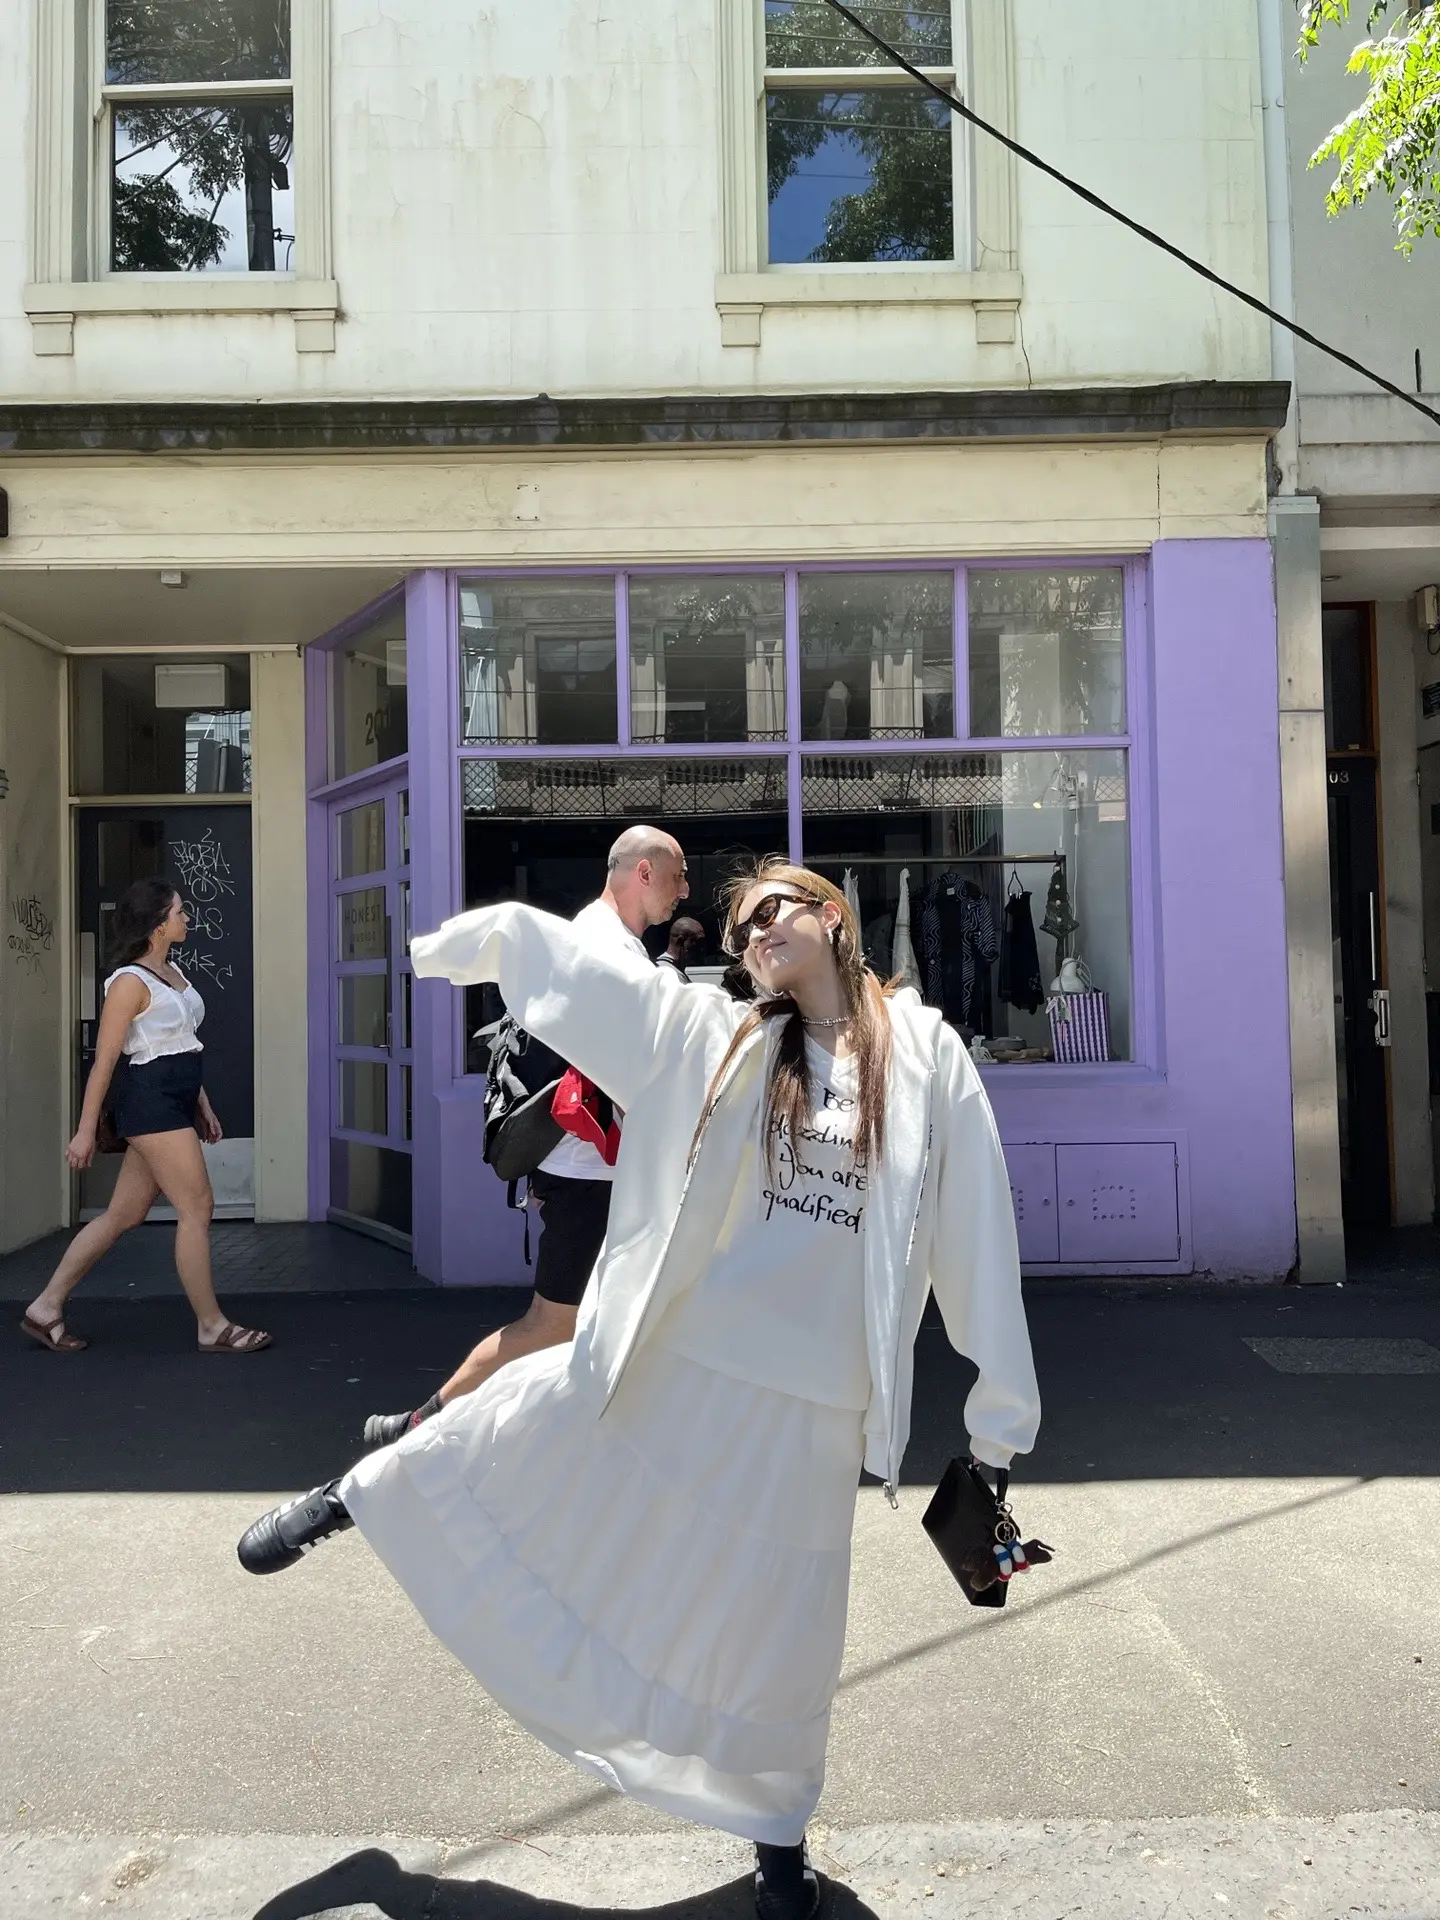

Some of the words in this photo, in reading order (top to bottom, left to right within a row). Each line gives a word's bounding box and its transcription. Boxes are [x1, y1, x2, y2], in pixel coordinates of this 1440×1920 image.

[344, 904, 381, 925] HONEST
[823, 1087, 856, 1112] Be
[832, 1170, 868, 1191] are
